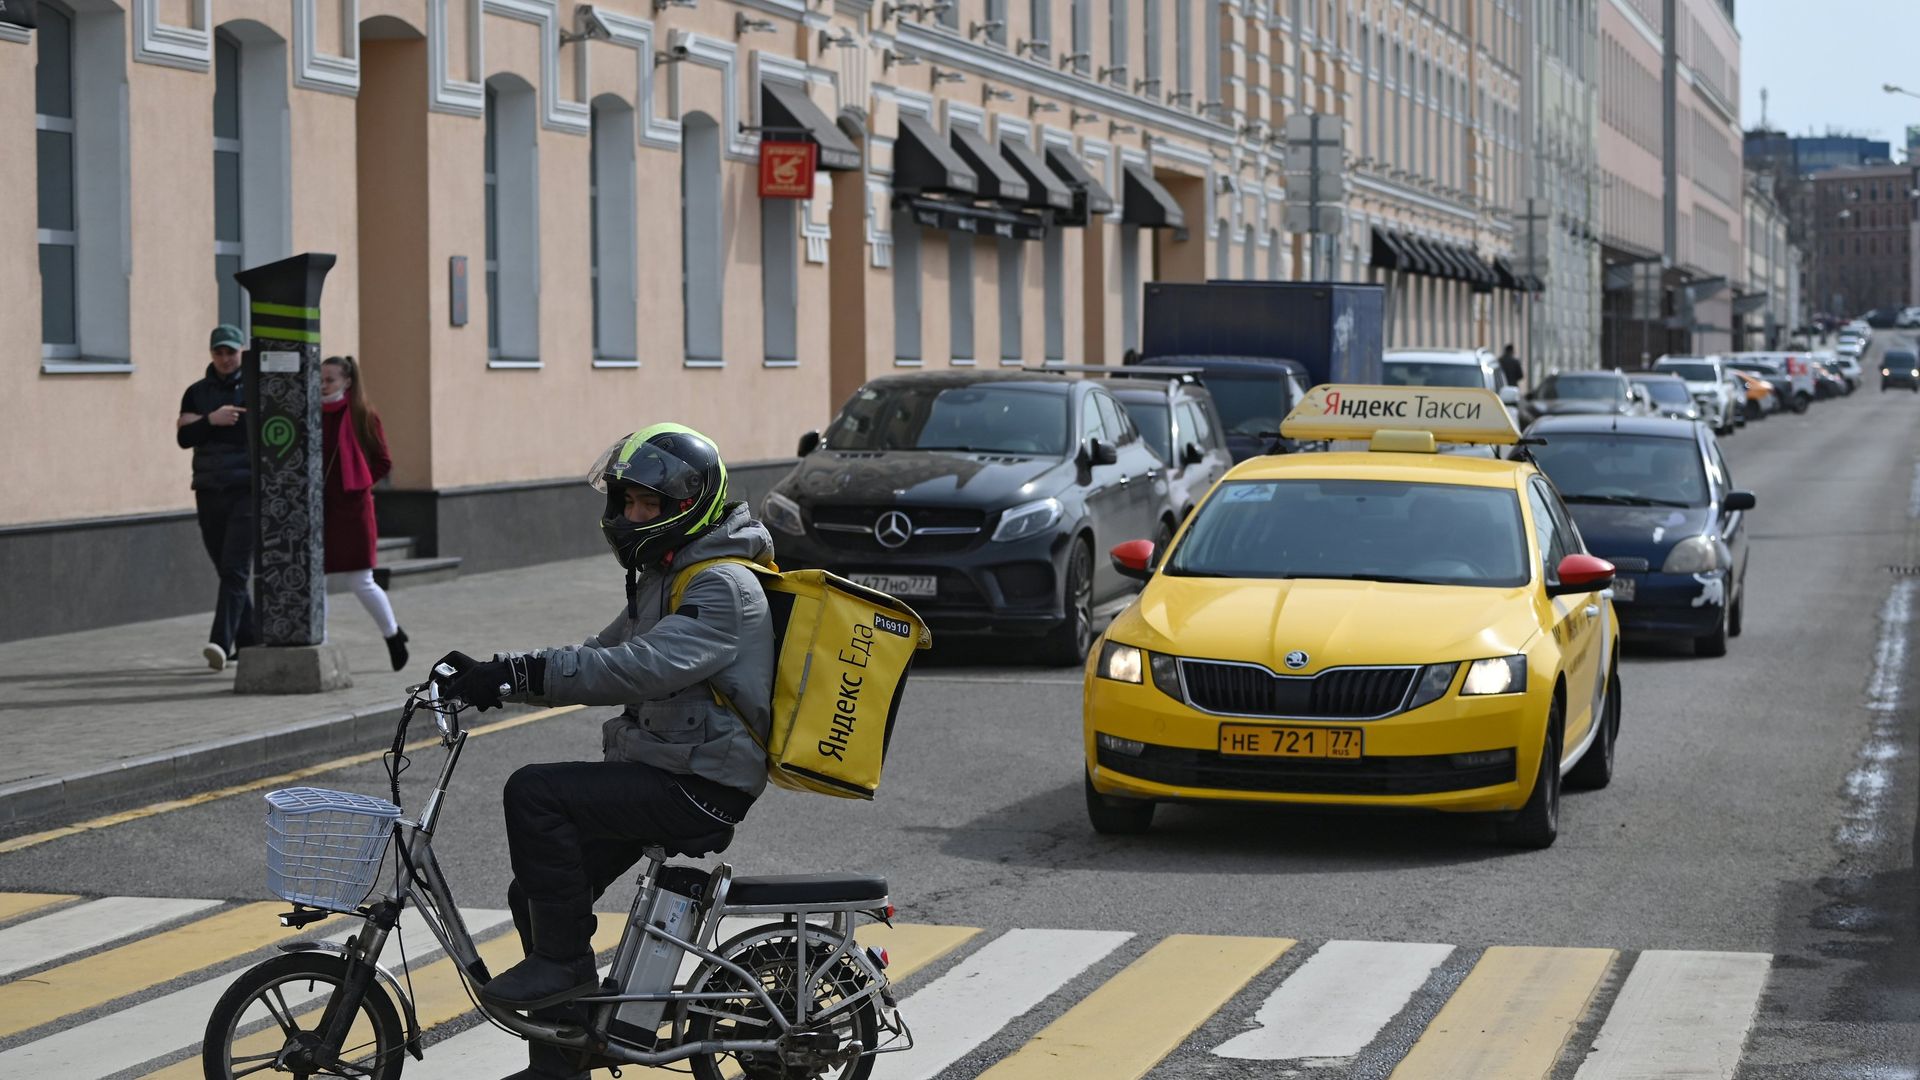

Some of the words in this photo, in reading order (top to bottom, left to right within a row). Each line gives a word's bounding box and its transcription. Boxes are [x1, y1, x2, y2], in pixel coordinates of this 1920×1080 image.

[1323, 391, 1407, 418] Яндекс
[1414, 395, 1481, 420] Такси
[874, 615, 909, 635] P16910
[838, 623, 875, 668] Еда
[818, 672, 863, 762] Яндекс
[1271, 730, 1314, 754] 721
[1330, 731, 1353, 748] 77
[1332, 748, 1350, 756] RUS
